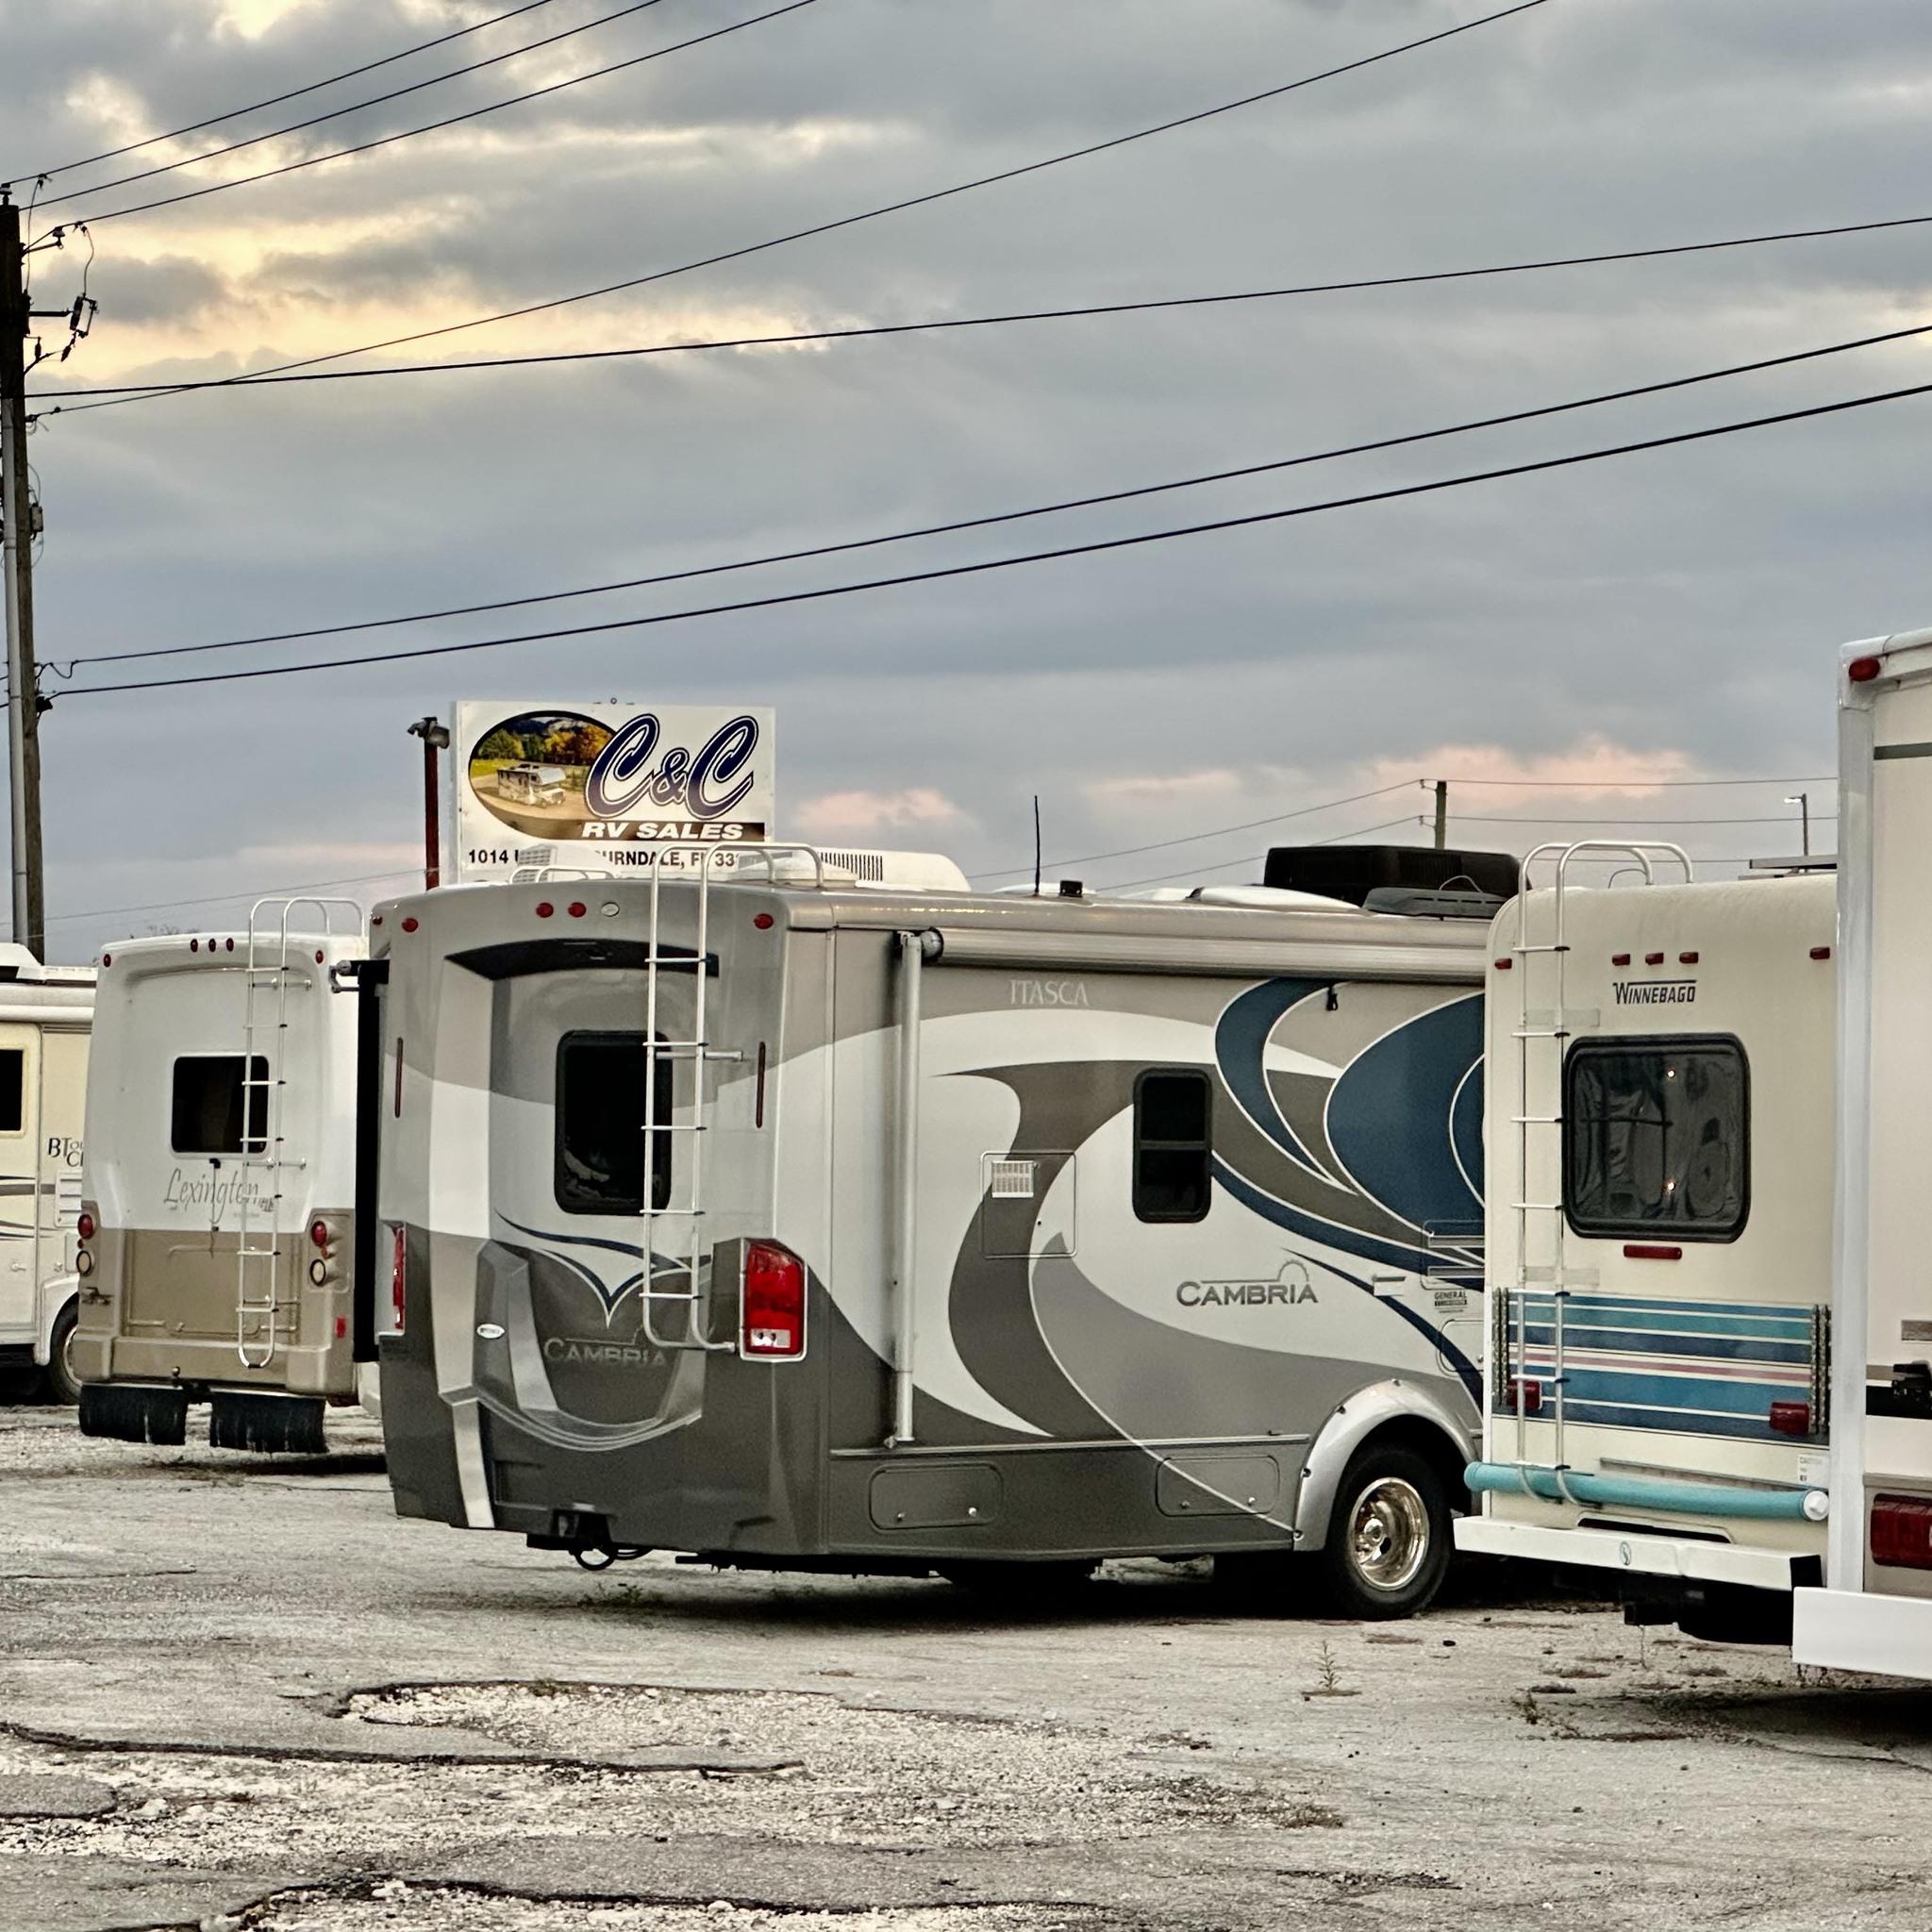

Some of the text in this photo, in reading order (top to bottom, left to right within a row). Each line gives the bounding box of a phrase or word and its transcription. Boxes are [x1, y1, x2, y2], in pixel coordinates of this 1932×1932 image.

[585, 713, 759, 820] C&C
[582, 822, 743, 840] RV SALES
[468, 849, 508, 864] 1014
[715, 852, 739, 867] 33
[1010, 979, 1090, 1006] ITASCA
[1612, 979, 1696, 1005] WINNEBAGO
[163, 1168, 259, 1224] Lexington
[1176, 1281, 1319, 1307] CAMBRIA
[544, 1338, 668, 1365] CAMBRIA
